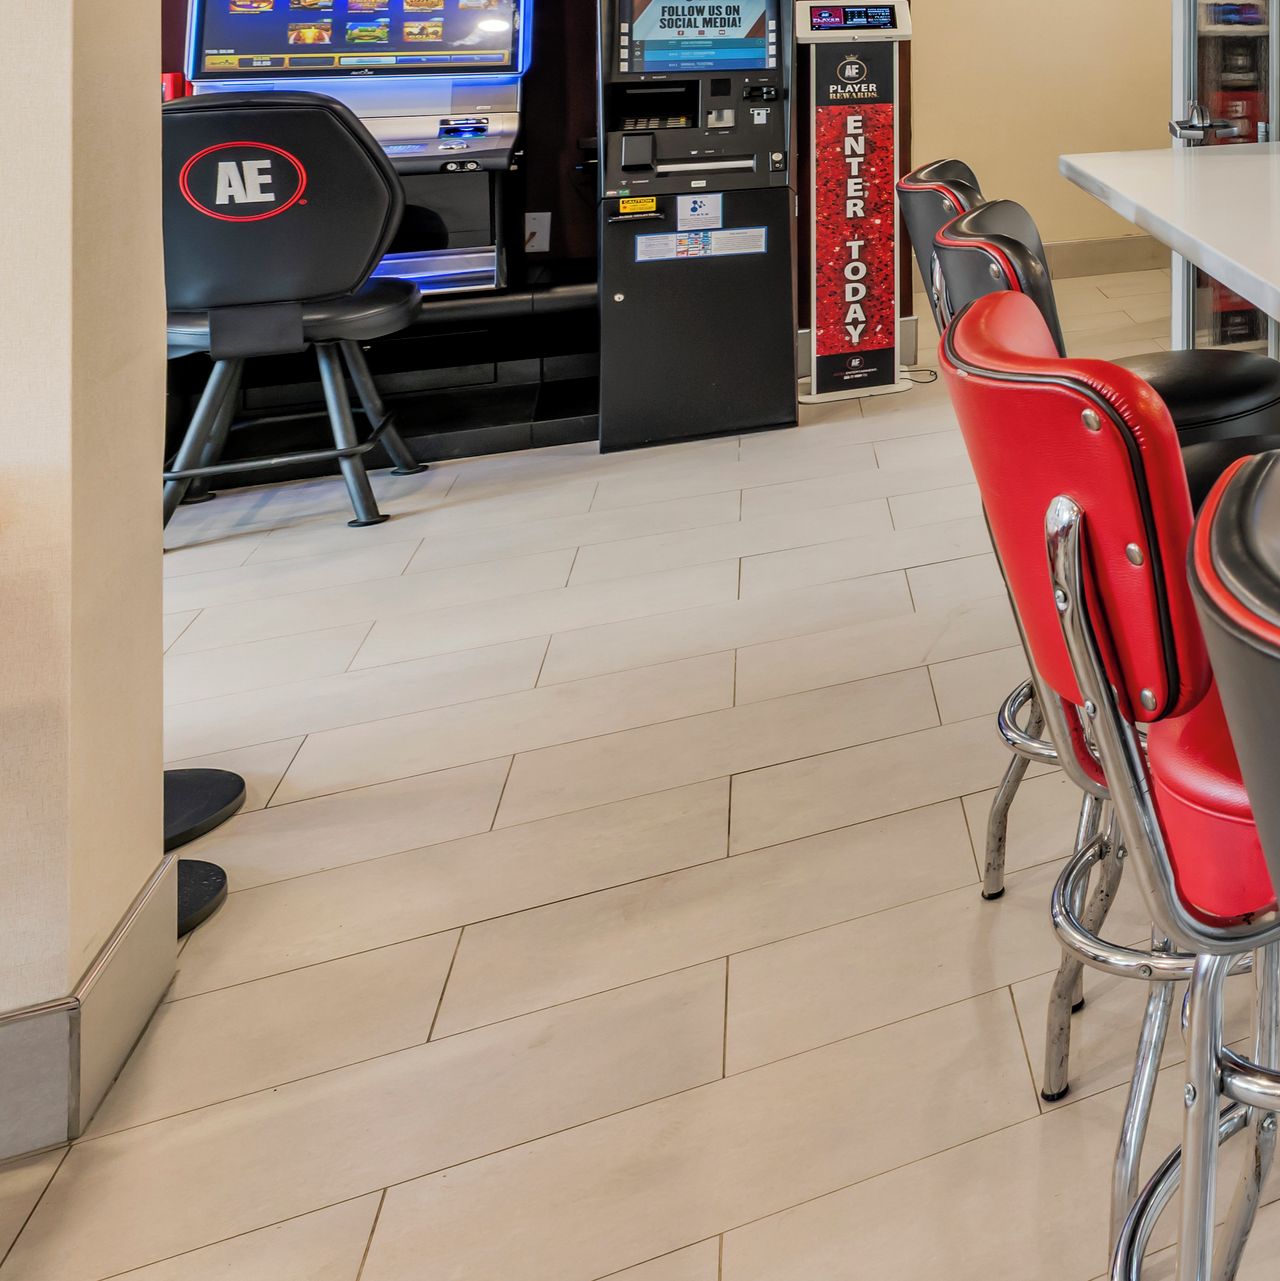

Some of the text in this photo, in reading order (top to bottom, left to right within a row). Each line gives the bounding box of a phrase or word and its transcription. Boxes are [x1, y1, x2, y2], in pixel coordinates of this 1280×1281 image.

[661, 5, 740, 17] FOLLOW US ON
[659, 16, 741, 29] SOCIAL MEDIA!
[844, 64, 859, 78] AE
[829, 83, 877, 93] PLAYER
[829, 92, 878, 100] REWARDS
[844, 115, 865, 218] ENTER
[215, 160, 275, 205] AE
[843, 240, 867, 343] TODAY
